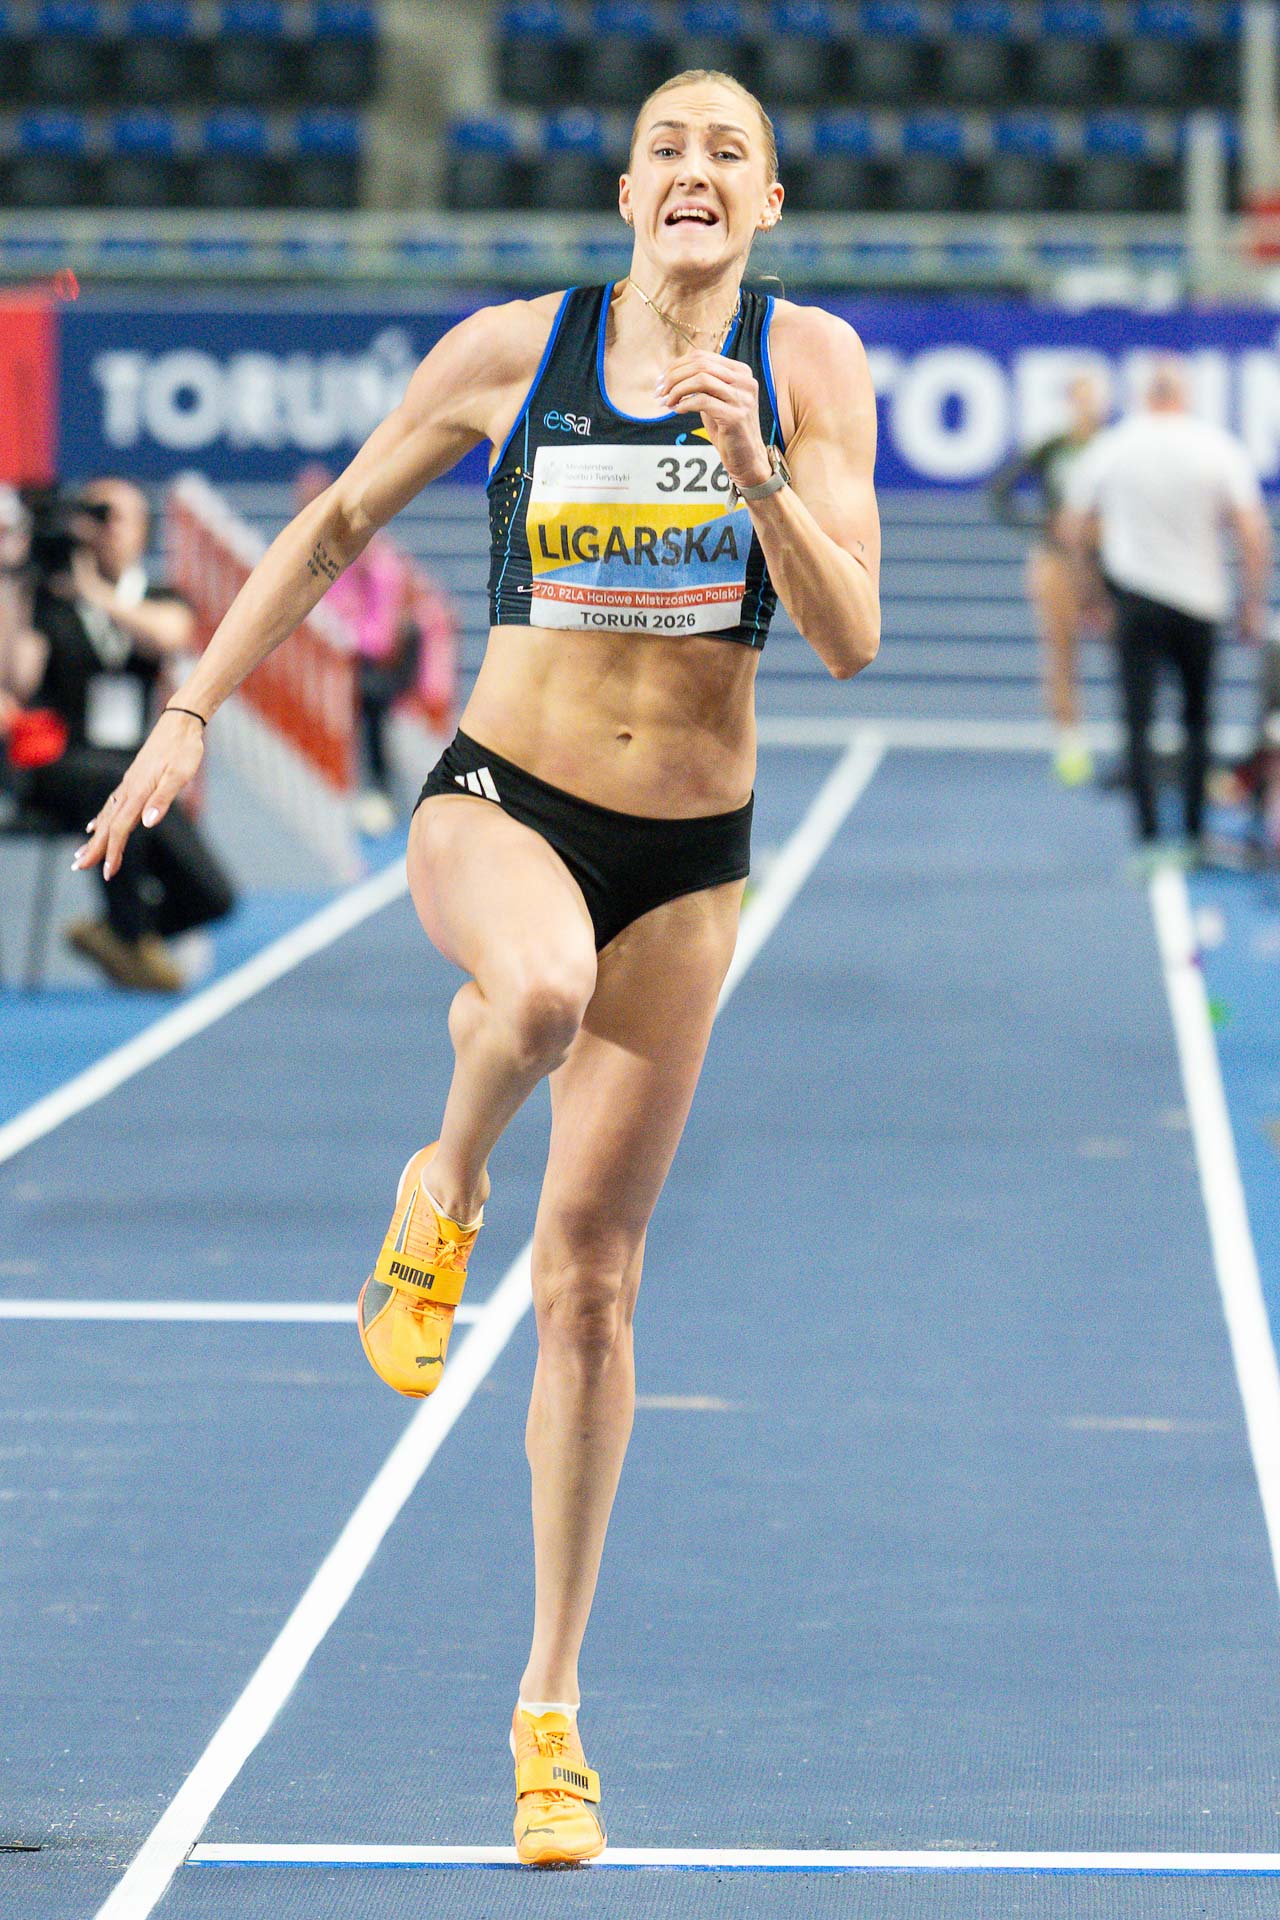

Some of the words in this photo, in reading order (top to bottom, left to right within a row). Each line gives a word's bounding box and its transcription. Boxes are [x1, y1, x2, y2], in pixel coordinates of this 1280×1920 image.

[656, 457, 731, 492] 326
[538, 523, 739, 567] LIGARSKA
[559, 587, 585, 601] PZLA
[587, 592, 633, 605] Halowe
[635, 592, 703, 606] Mistrzostwa
[705, 587, 737, 601] Polski
[580, 610, 647, 628] TORUŃ
[653, 613, 696, 629] 2026
[388, 1260, 436, 1290] PUMA
[552, 1766, 589, 1790] PUMA
